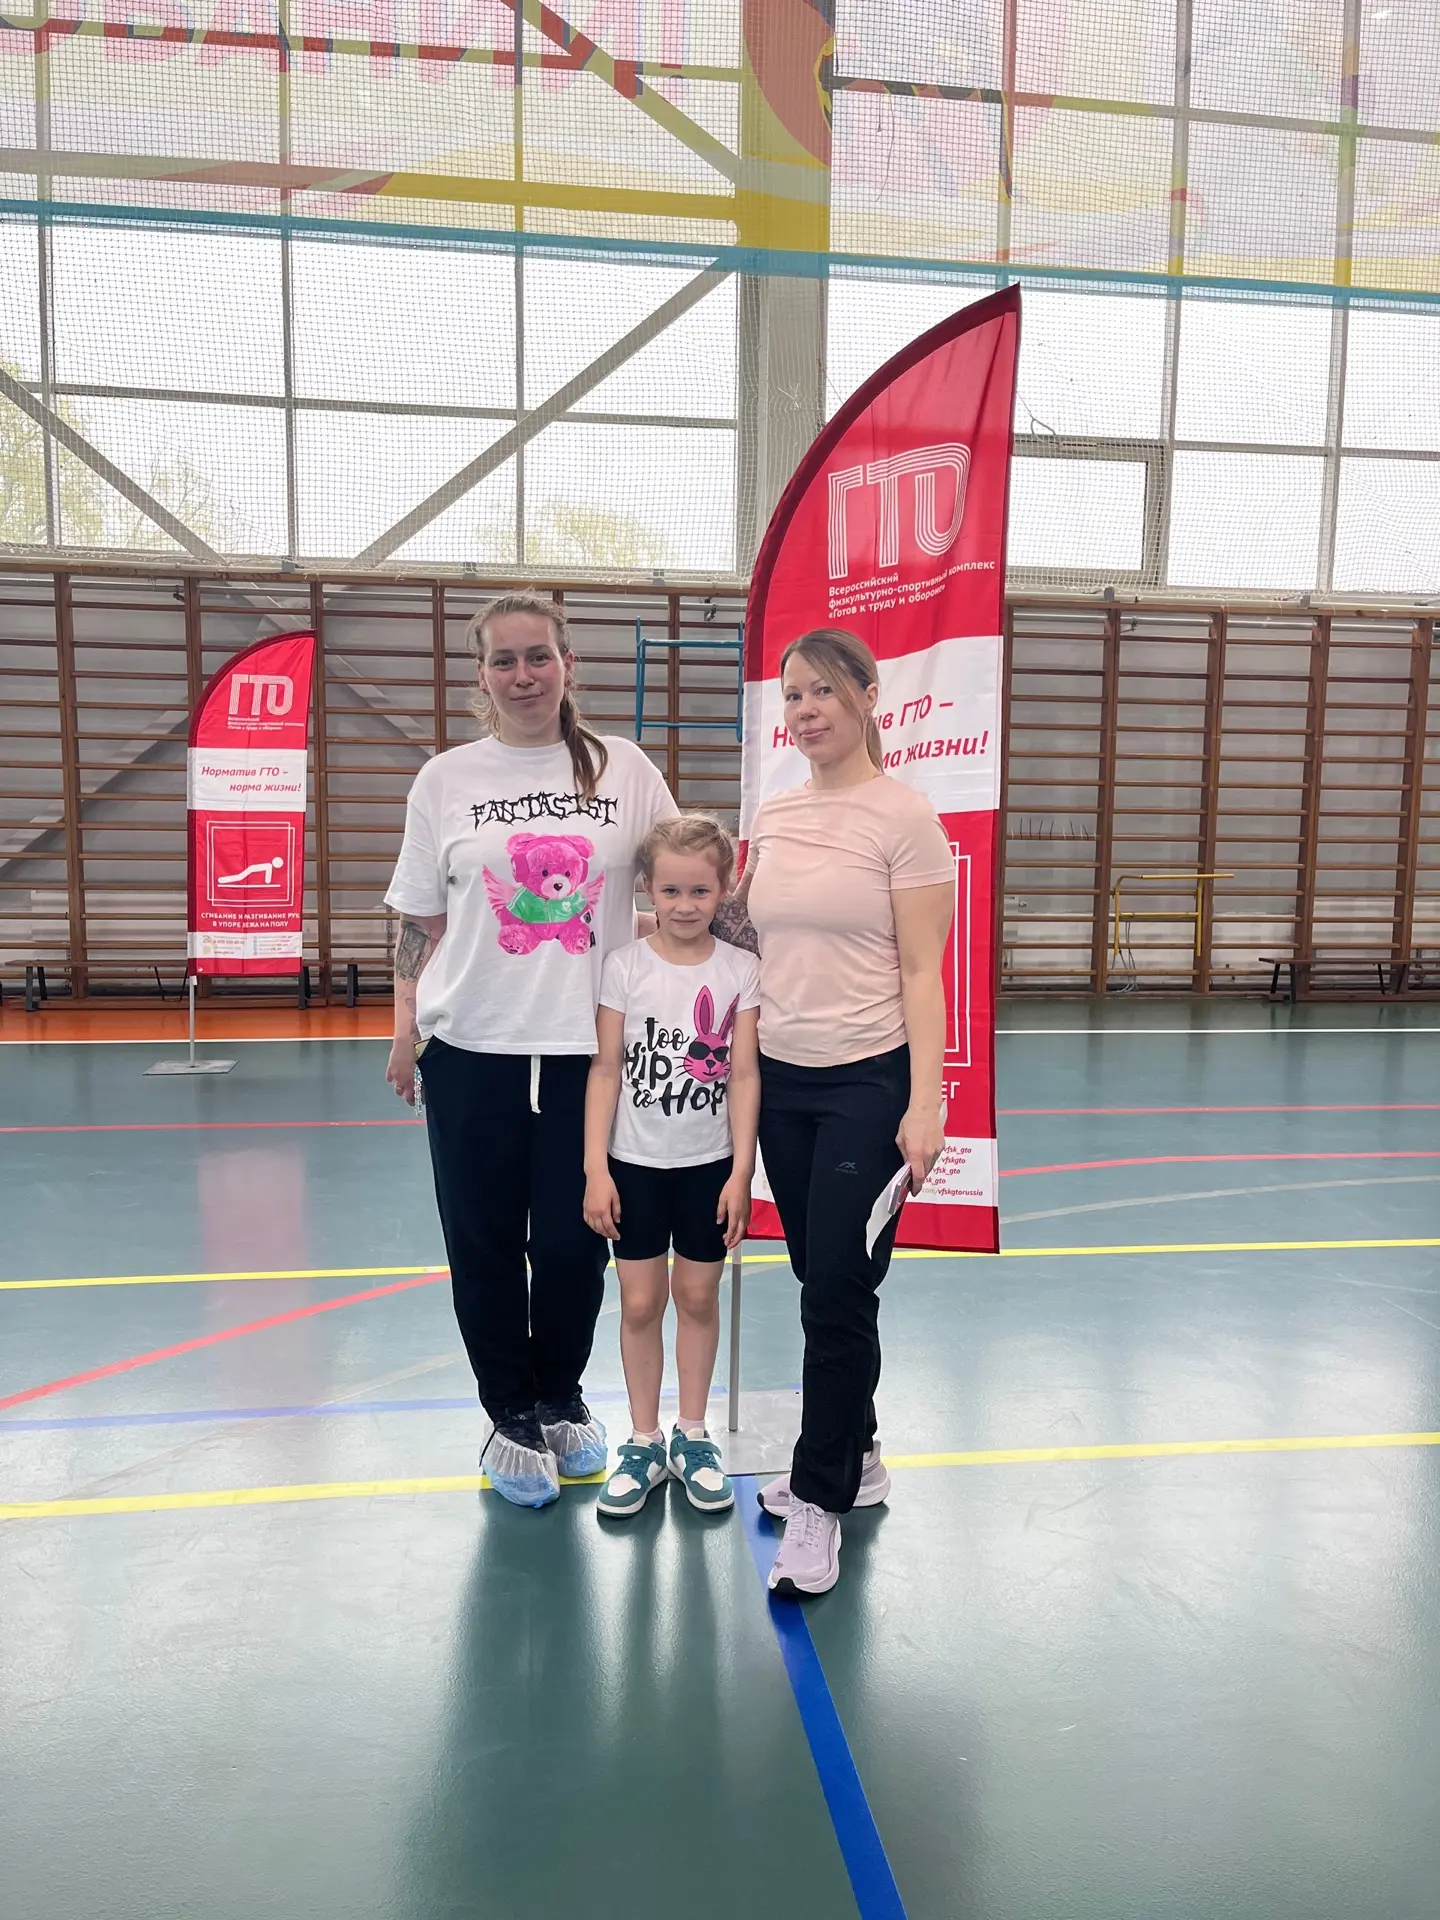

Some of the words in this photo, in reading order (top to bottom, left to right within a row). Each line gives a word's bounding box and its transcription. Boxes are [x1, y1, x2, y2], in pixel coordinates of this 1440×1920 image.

[828, 442, 972, 580] ГТО
[828, 572, 899, 596] Всероссийский
[828, 569, 948, 609] физкультурно-спортивный
[948, 561, 995, 578] комплекс
[860, 602, 866, 613] к
[868, 597, 896, 613] труду
[899, 595, 905, 605] и
[228, 673, 294, 716] ГТО
[899, 694, 932, 727] ГТО
[904, 730, 989, 765] жизни!
[201, 766, 257, 778] Норматив
[259, 767, 280, 777] ГТО
[229, 784, 262, 793] норма
[263, 783, 302, 792] жизни!
[941, 1081, 960, 1099] ЕГ
